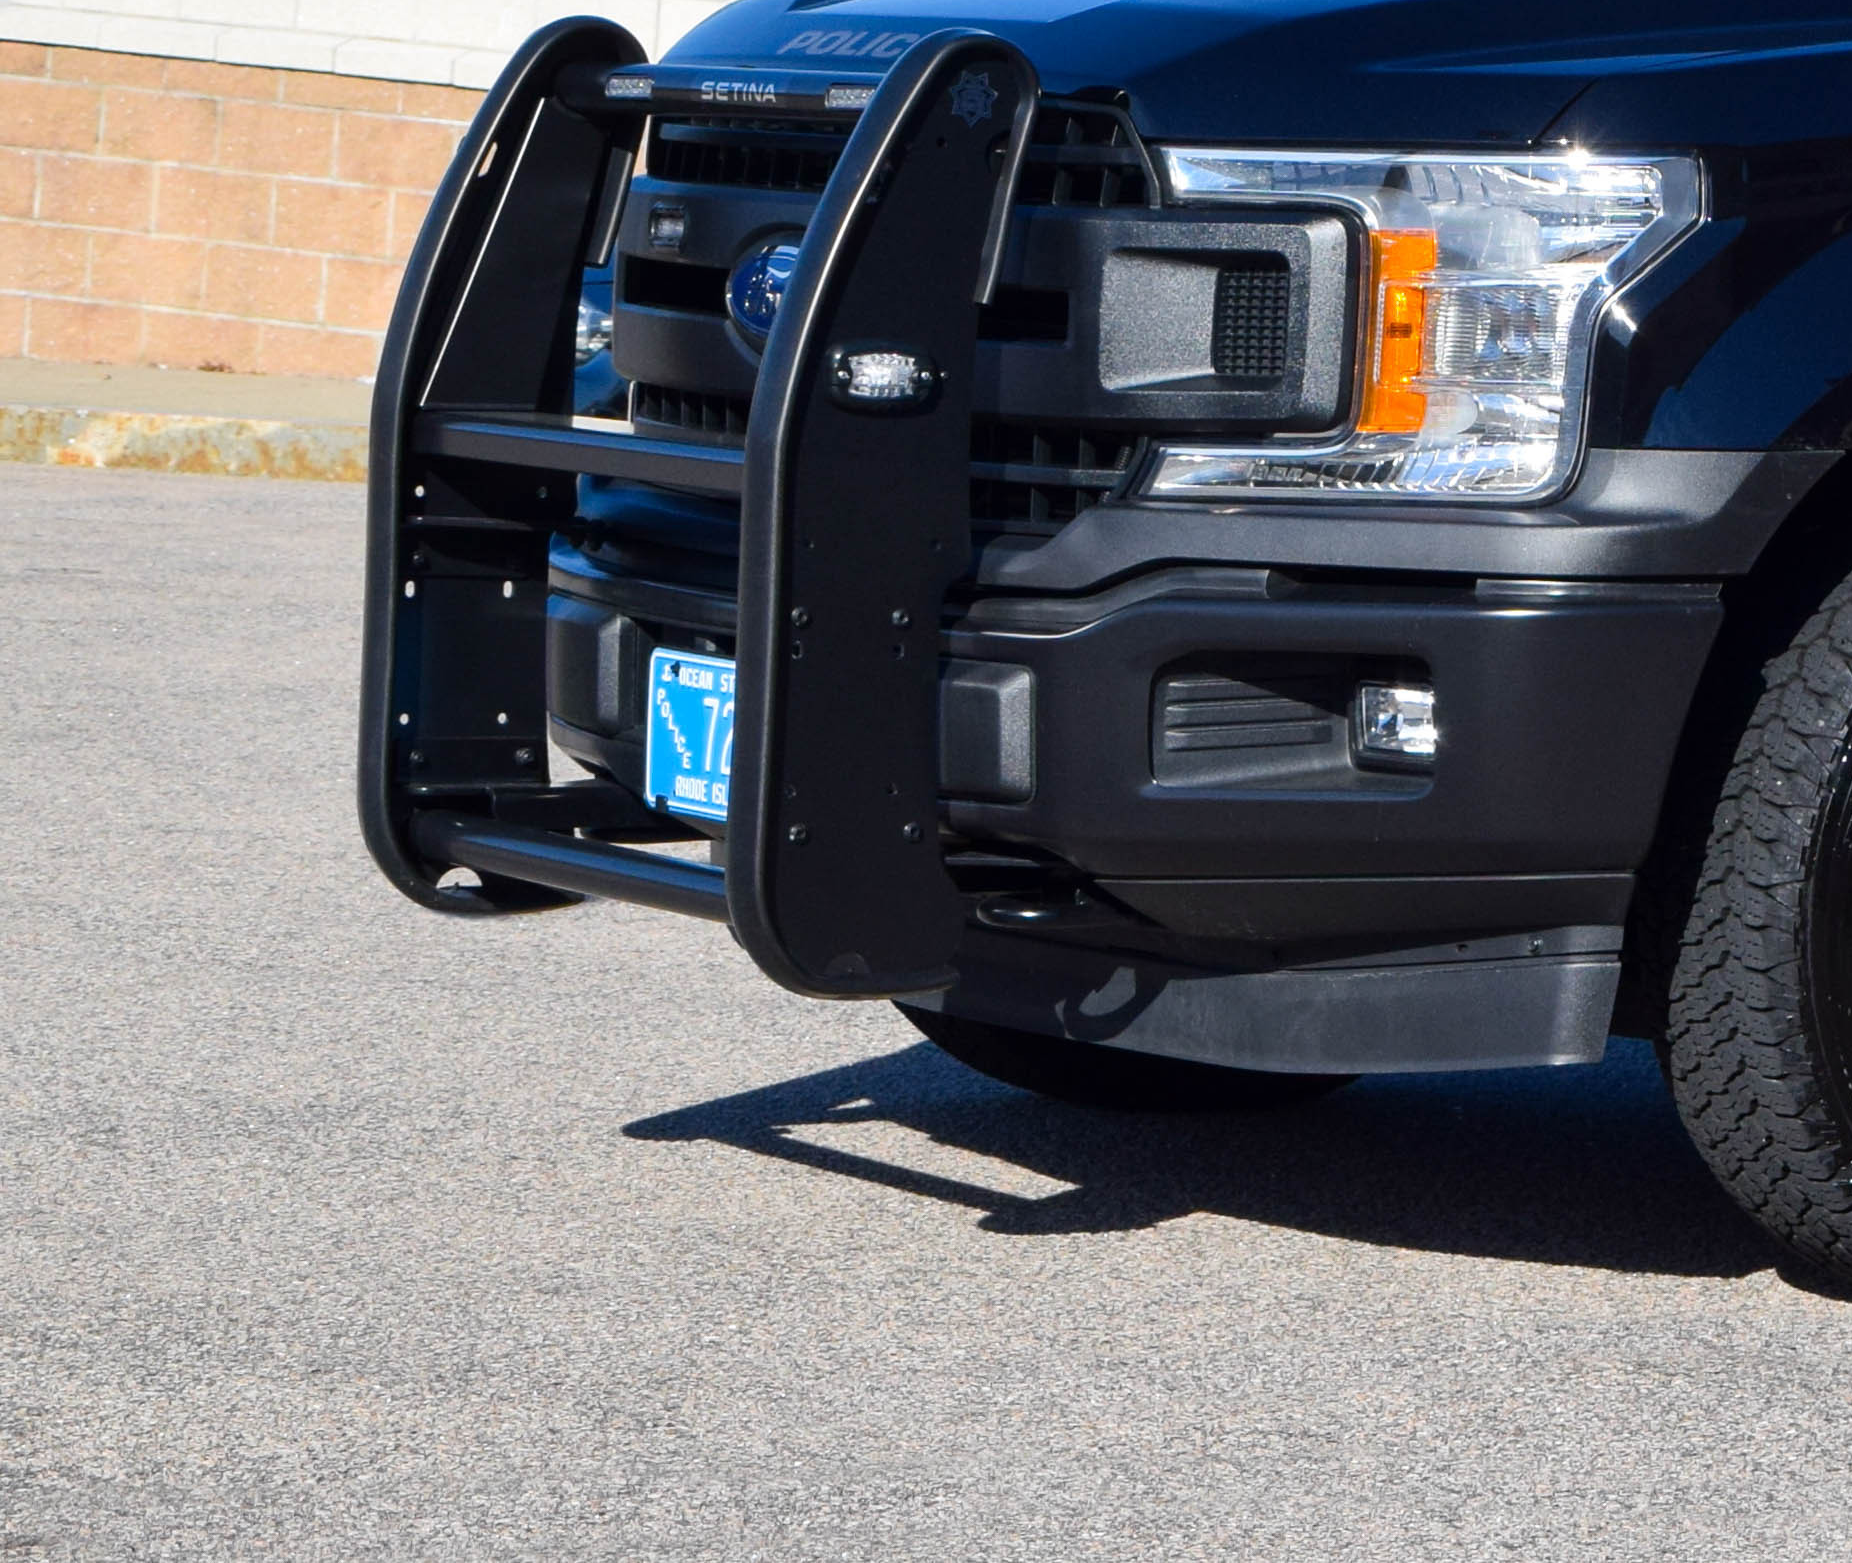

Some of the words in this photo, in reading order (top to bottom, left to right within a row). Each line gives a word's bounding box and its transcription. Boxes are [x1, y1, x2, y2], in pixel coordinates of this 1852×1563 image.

[701, 80, 777, 103] SETINA
[679, 666, 713, 691] OCEAN
[657, 688, 693, 770] POLICE
[674, 775, 708, 803] RHODE
